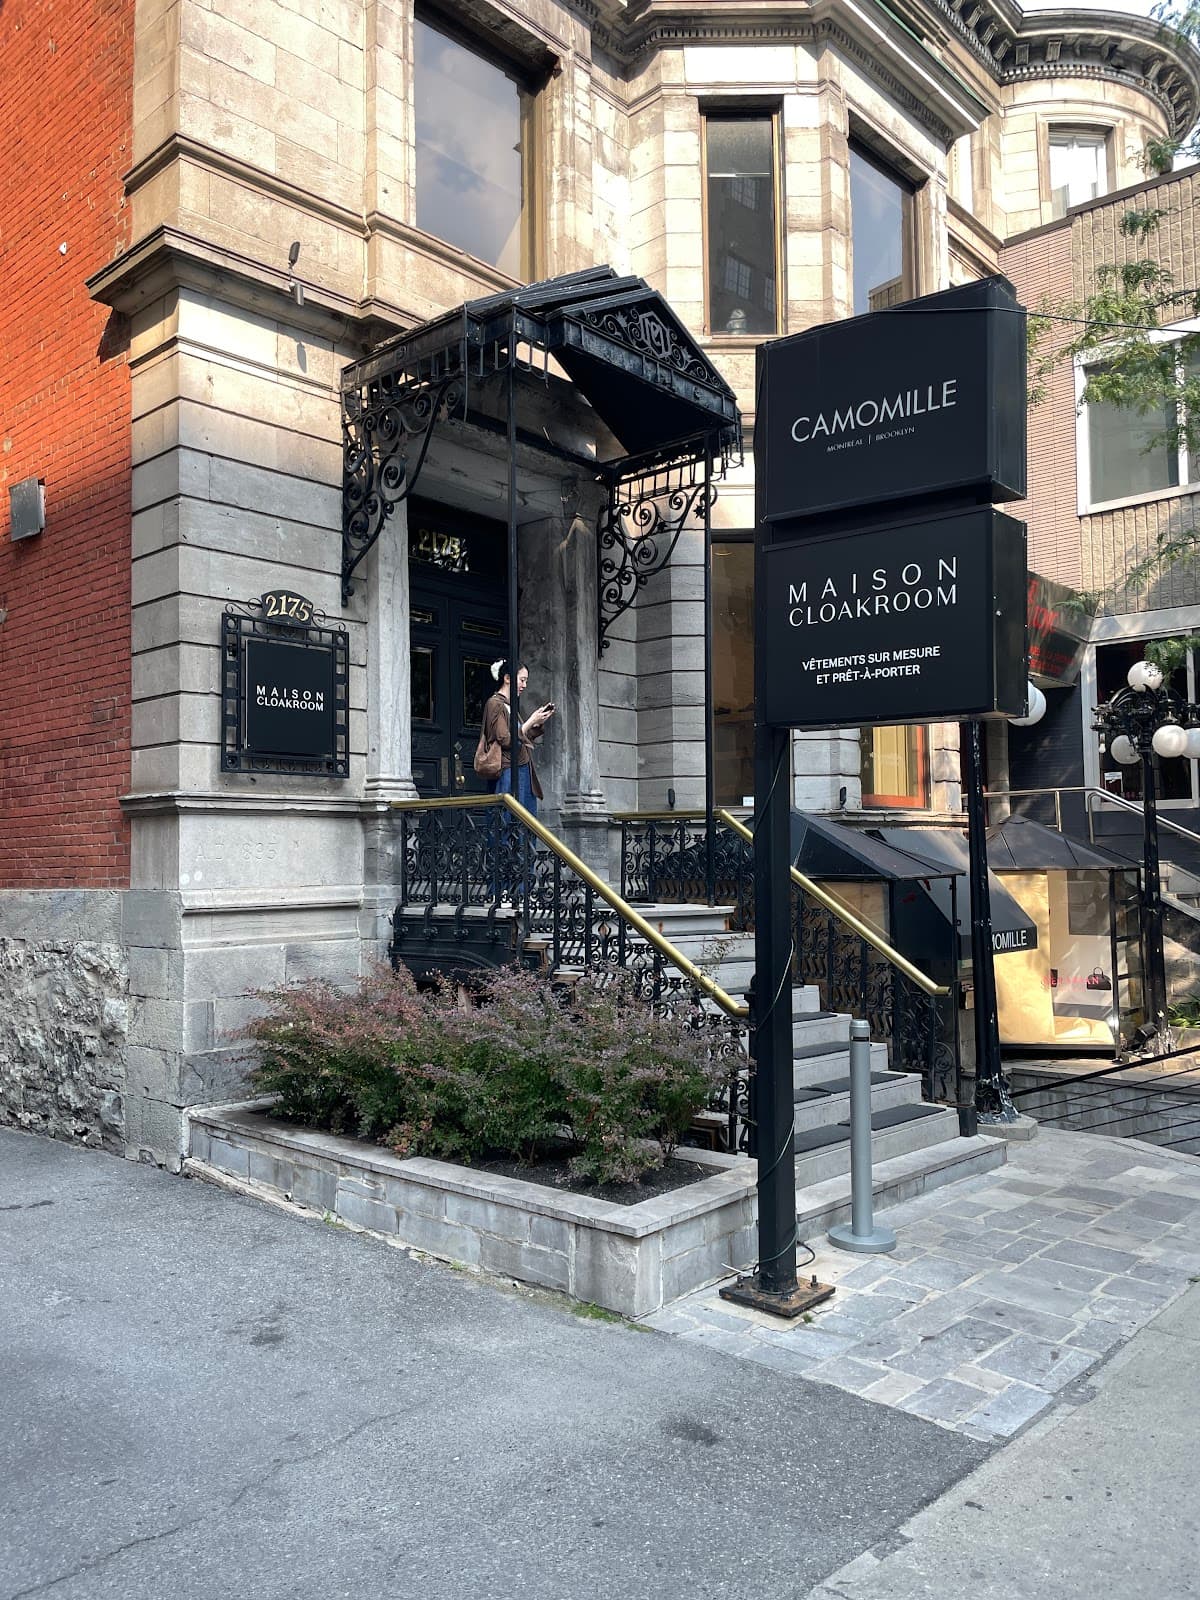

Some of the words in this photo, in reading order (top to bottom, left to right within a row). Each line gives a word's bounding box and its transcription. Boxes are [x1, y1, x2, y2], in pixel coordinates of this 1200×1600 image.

[790, 379, 957, 442] CAMOMILLE
[875, 426, 915, 441] BROOKLYN
[788, 556, 958, 605] MAISON
[265, 595, 312, 622] 2175
[788, 584, 958, 627] CLOAKROOM
[801, 654, 866, 672] VÊTEMENTS
[868, 650, 890, 664] SUR
[892, 645, 941, 661] MESURE
[816, 673, 830, 685] ET
[832, 664, 921, 682] PRÊT-À-PORTER
[256, 685, 325, 702] MAISON
[256, 697, 325, 712] CLOAKROOM
